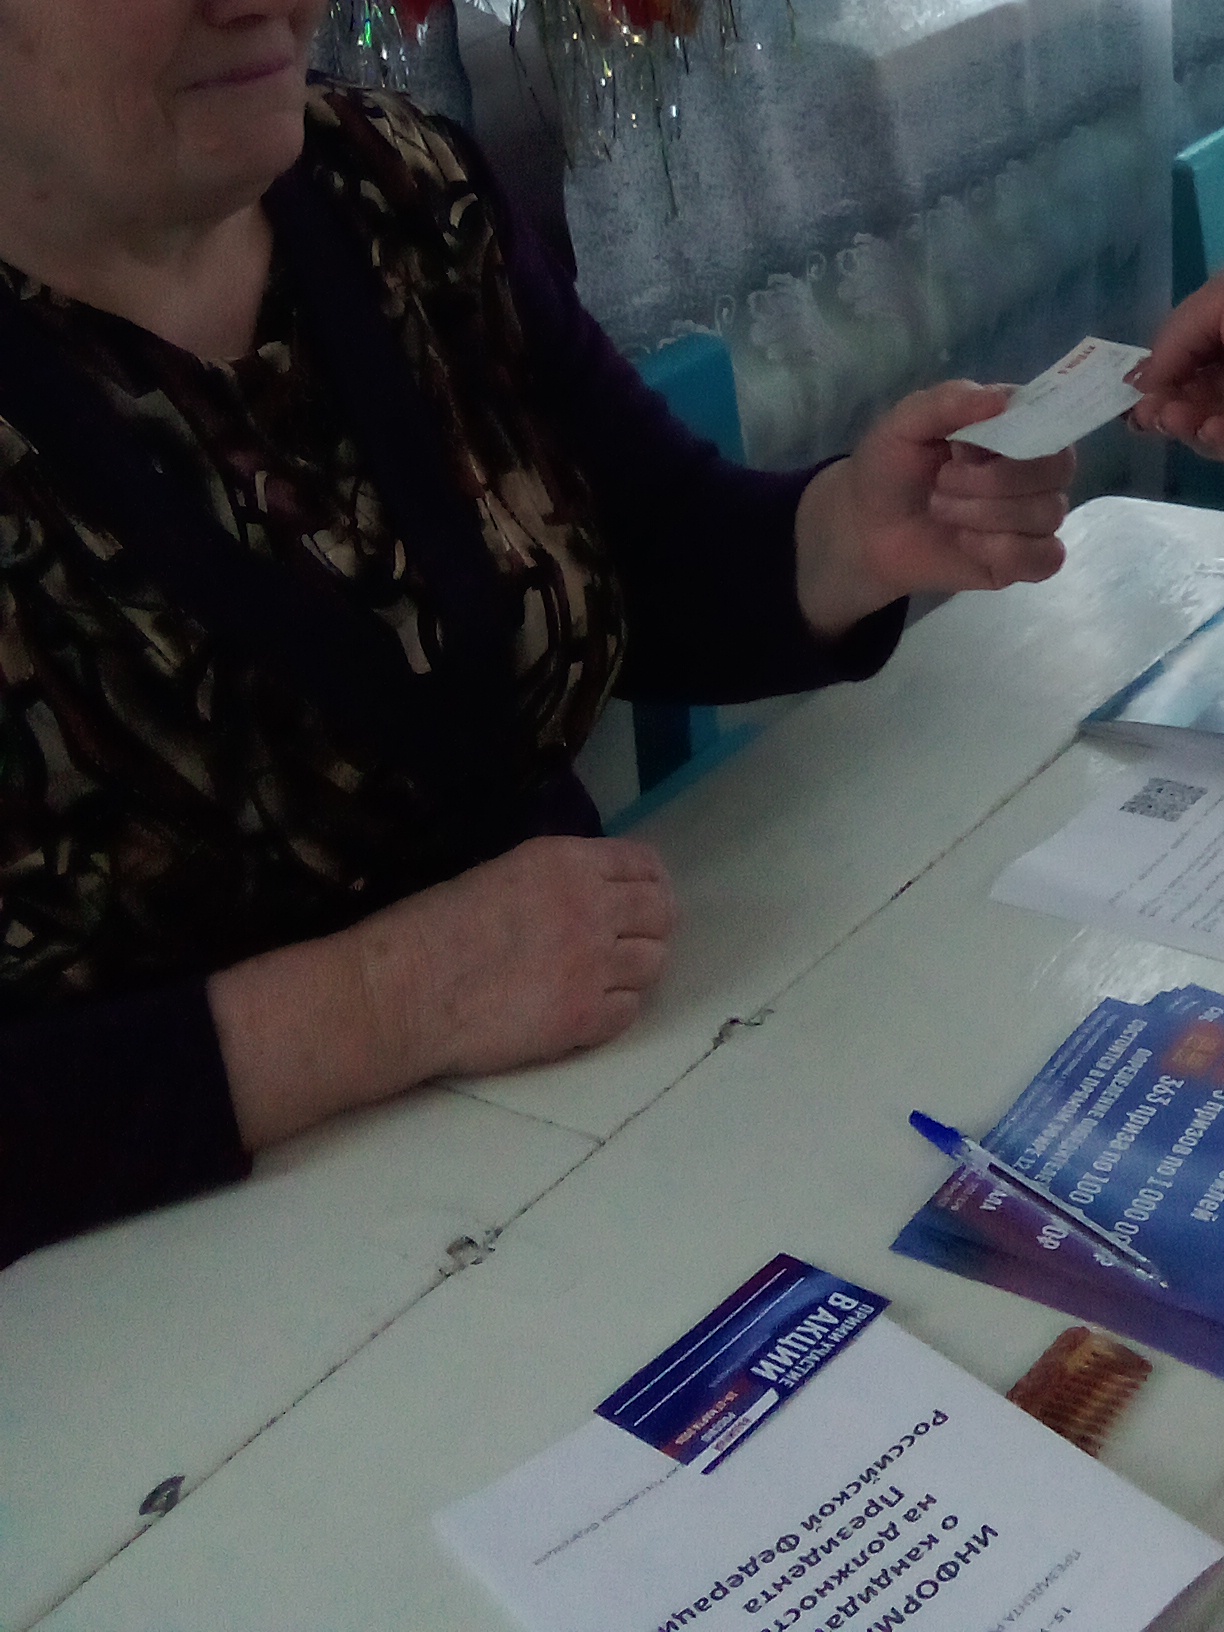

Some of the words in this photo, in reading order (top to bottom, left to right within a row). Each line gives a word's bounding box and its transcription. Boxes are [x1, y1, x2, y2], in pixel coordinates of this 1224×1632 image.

[1141, 1073, 1186, 1107] 363
[1102, 1101, 1161, 1153] приза
[1089, 1149, 1125, 1174] по
[1154, 1154, 1186, 1177] по
[1065, 1171, 1110, 1205] 100
[826, 1292, 859, 1314] В
[827, 1301, 875, 1345] ПРИМИ
[750, 1304, 839, 1384] АКЦИИ
[778, 1340, 835, 1389] УЧАСТИЕ
[801, 1407, 950, 1533] Российской
[902, 1493, 938, 1524] на
[940, 1514, 959, 1531] о
[743, 1484, 905, 1613] Президента
[814, 1533, 940, 1632] кандида
[866, 1524, 999, 1632] ИНФОРМ
[1003, 1548, 1082, 1623] ПРЕЗИДЕНТА
